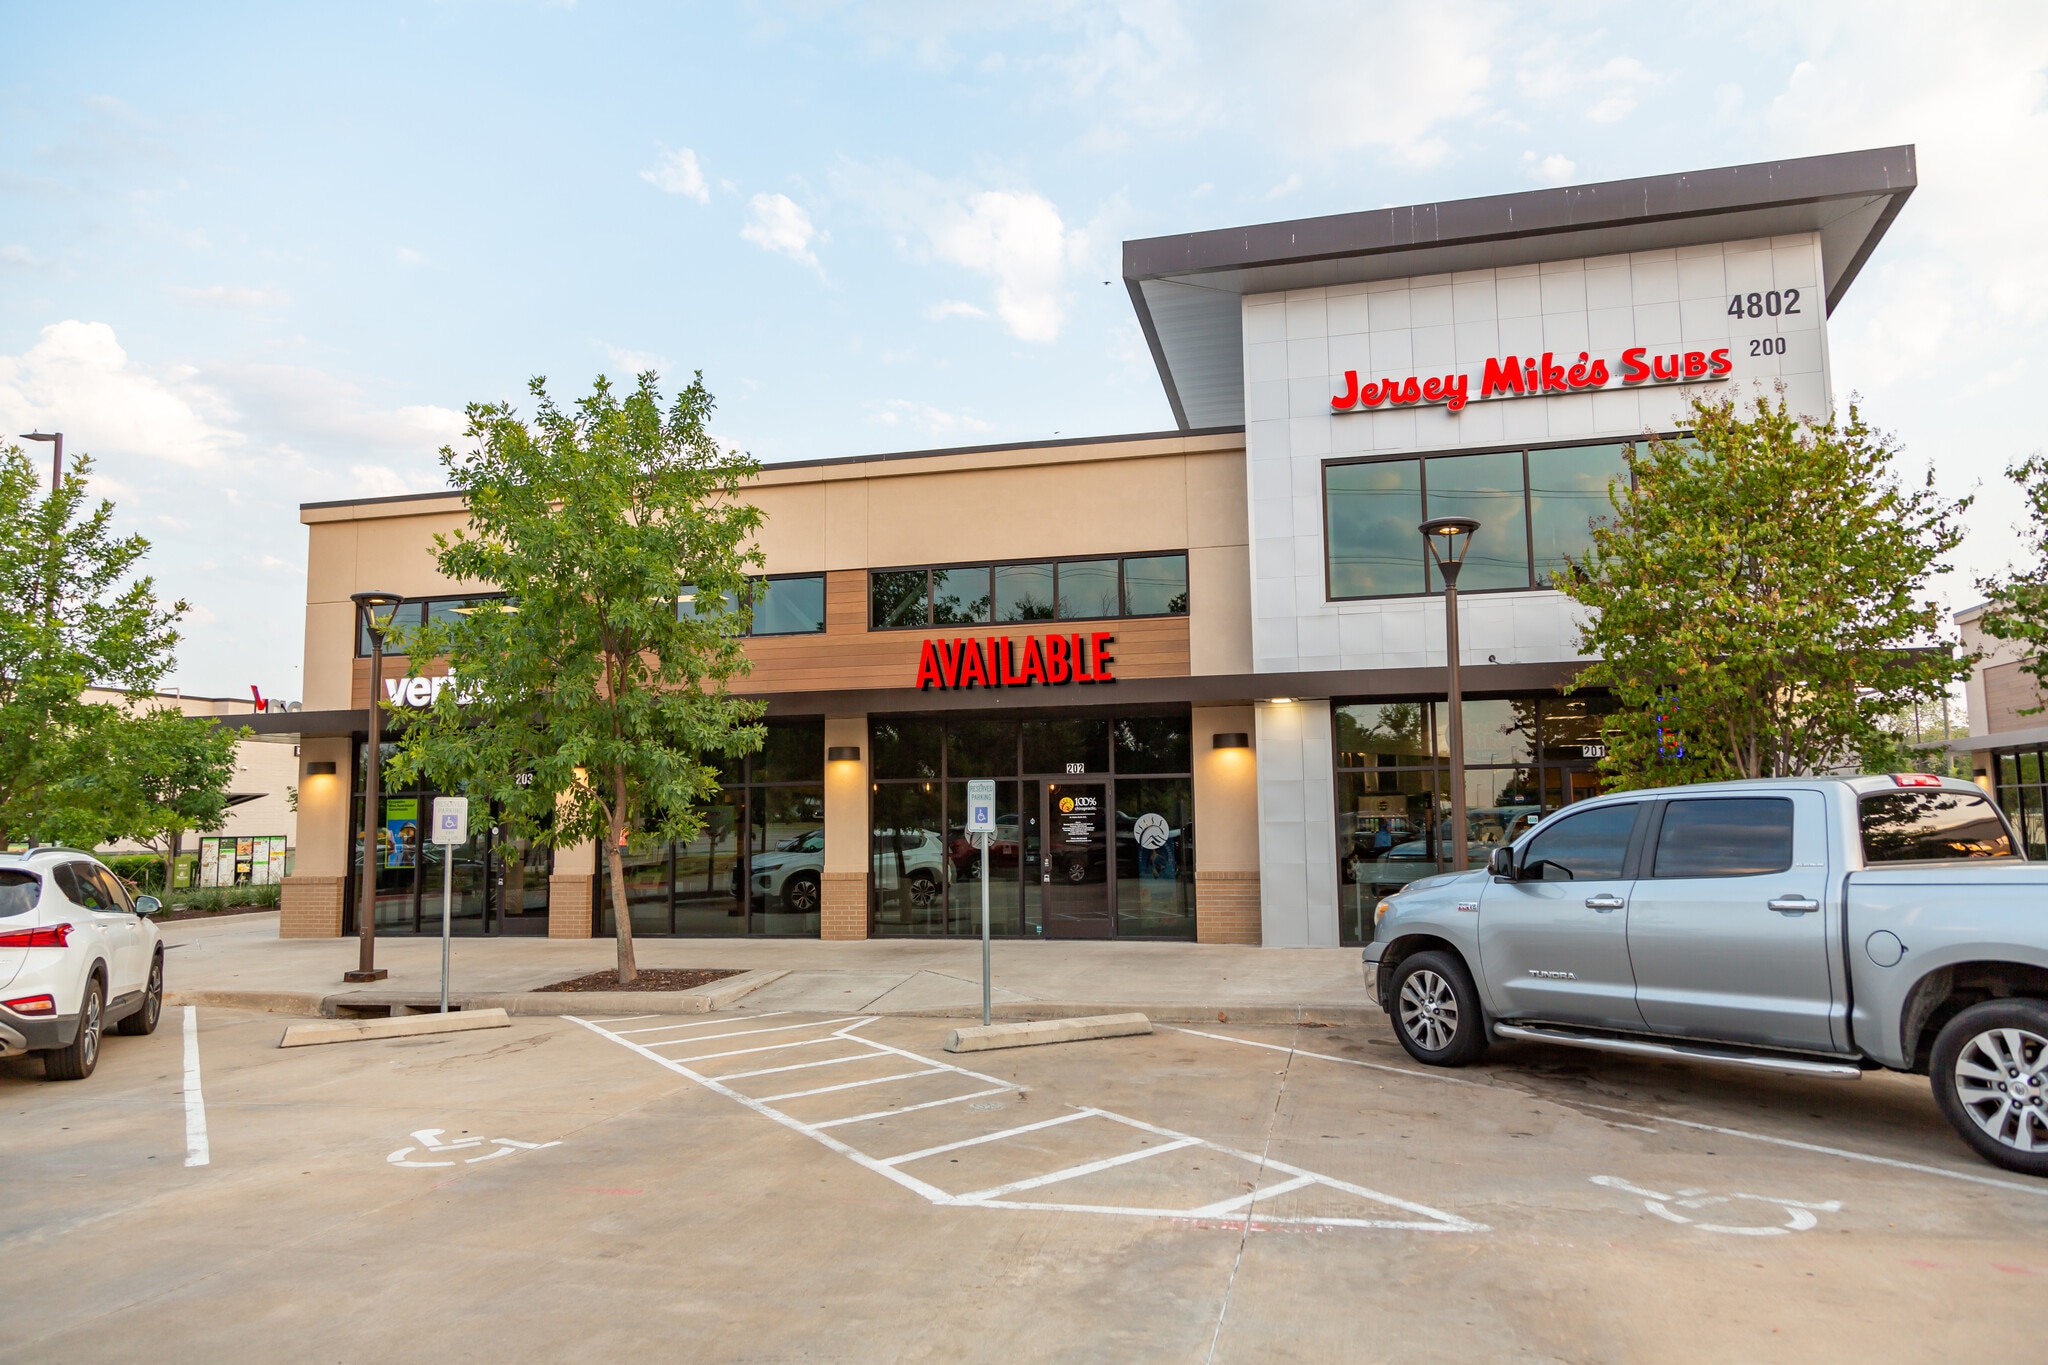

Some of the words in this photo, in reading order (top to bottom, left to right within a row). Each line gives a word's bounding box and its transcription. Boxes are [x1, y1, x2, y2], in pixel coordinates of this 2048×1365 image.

[1727, 289, 1801, 320] 4802
[1749, 337, 1786, 357] 200
[1331, 370, 1469, 412] Jersey
[1481, 351, 1610, 398] Mike's
[915, 631, 1116, 690] AVAILABLE
[1584, 745, 1604, 757] 201
[1066, 763, 1085, 774] 202
[515, 773, 533, 785] 203
[1074, 797, 1097, 806] 100%
[1528, 969, 1577, 980] TUNDRA
